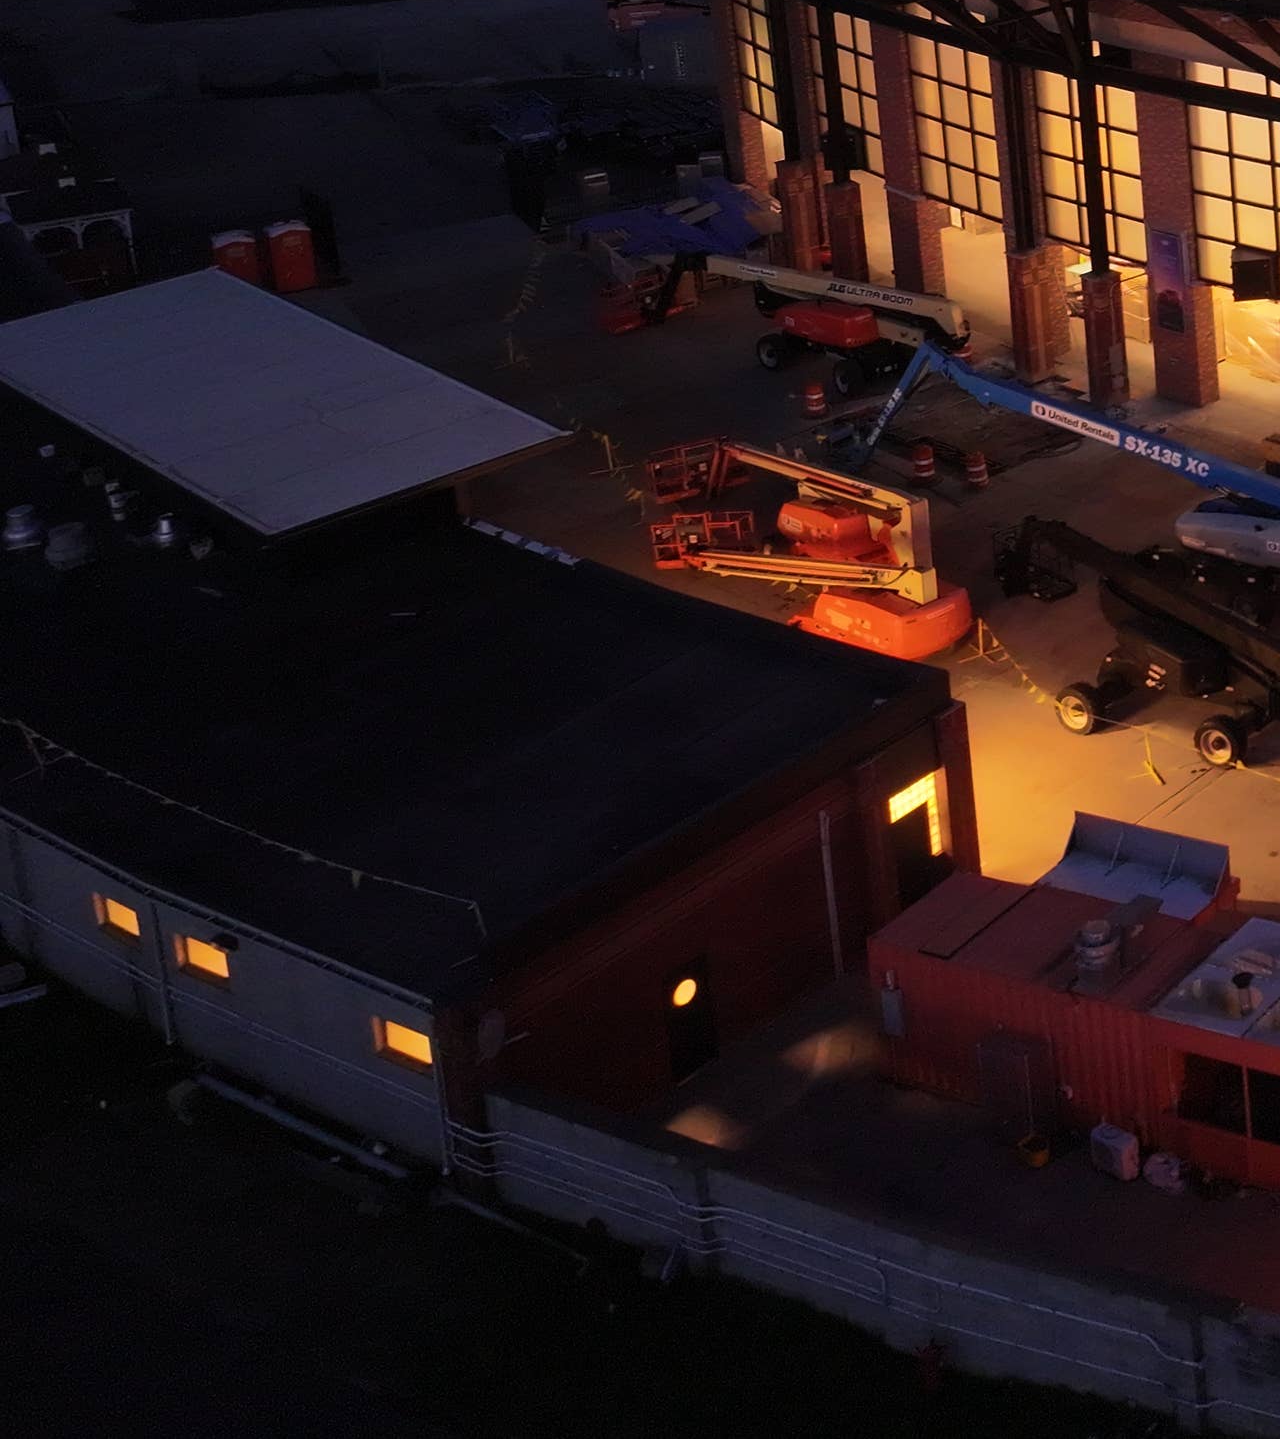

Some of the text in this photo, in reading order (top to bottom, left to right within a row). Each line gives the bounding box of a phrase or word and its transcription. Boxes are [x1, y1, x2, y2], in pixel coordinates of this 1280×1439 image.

[882, 293, 913, 306] BOOM
[1048, 409, 1210, 478] United Rentals SX-135 XC
